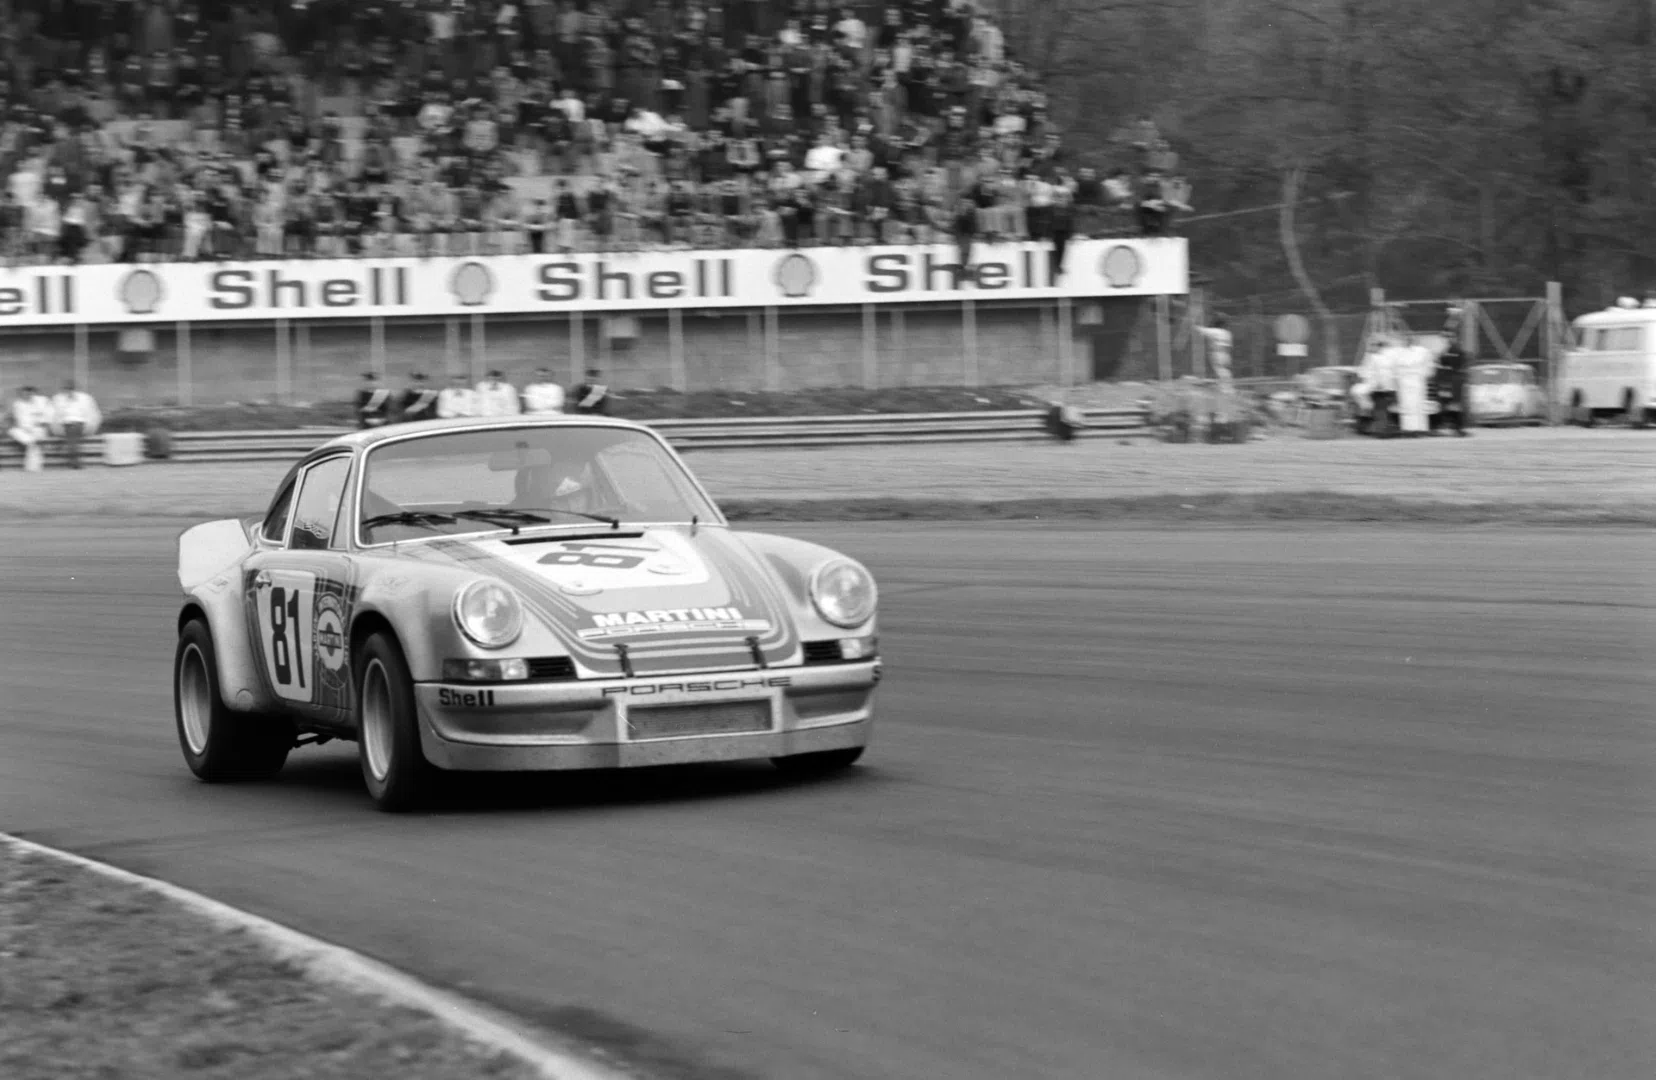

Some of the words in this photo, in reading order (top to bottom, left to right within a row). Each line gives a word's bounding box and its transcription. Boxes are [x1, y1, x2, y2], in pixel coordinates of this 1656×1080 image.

[207, 267, 409, 309] Shell
[535, 258, 732, 301] Shell
[865, 250, 1061, 293] Shell
[537, 543, 660, 568] 81
[592, 607, 742, 627] MARTINI
[270, 587, 305, 688] 81
[439, 688, 495, 706] Shell
[602, 676, 792, 697] PORSCHE
